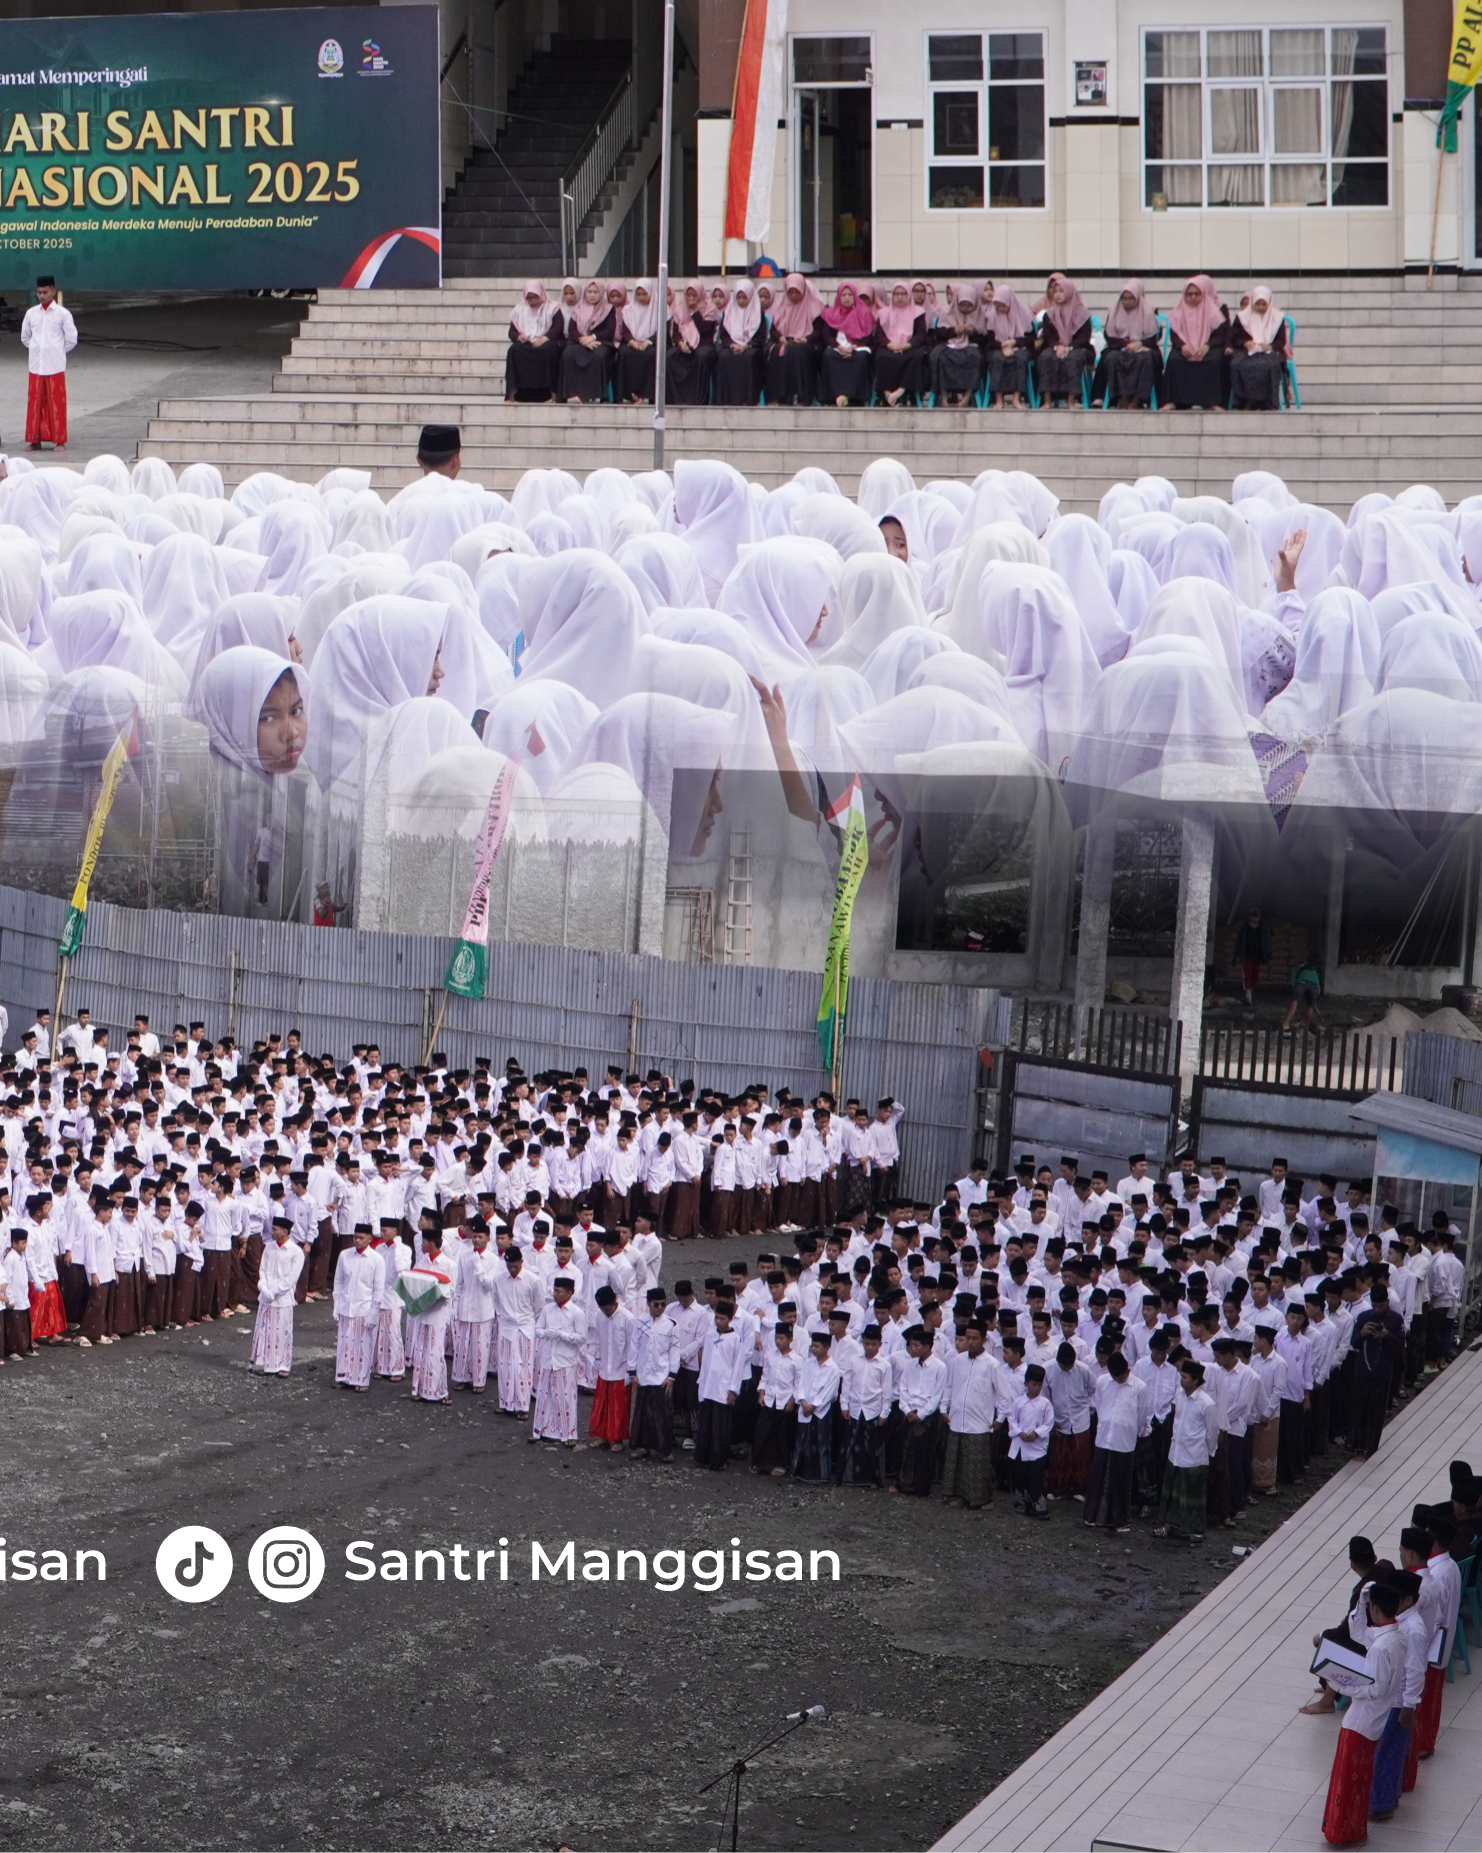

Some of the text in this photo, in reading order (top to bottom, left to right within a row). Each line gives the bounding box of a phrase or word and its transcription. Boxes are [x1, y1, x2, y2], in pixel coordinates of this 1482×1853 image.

[1452, 36, 1475, 70] PP
[39, 66, 148, 88] Memperingati
[106, 104, 295, 151] SANTRI
[247, 158, 360, 204] 2025
[40, 219, 99, 231] Indonesia
[101, 218, 155, 230] Merdeka
[158, 218, 203, 232] Menuju
[205, 216, 273, 229] Peradaban
[43, 238, 73, 249] 2025
